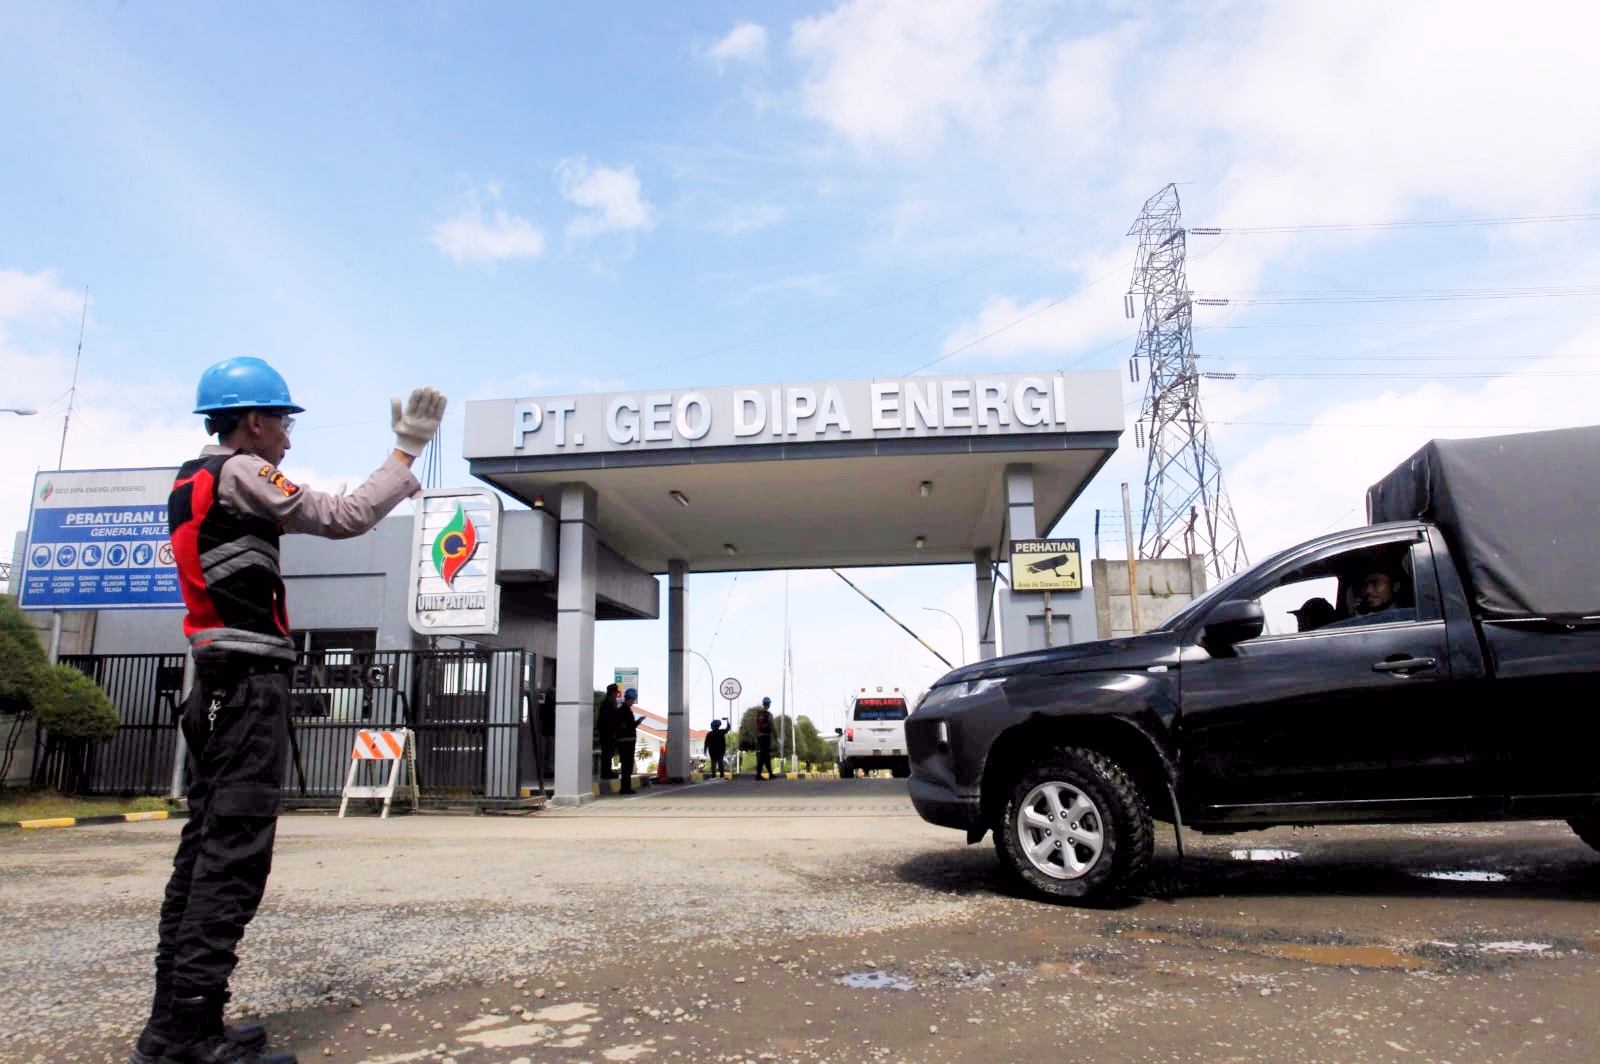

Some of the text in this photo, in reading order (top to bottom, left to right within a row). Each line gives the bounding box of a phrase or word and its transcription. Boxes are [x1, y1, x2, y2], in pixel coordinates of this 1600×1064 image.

[513, 377, 1066, 449] PT. GEO DIPA ENERGI
[66, 511, 154, 525] PERATURAN
[91, 527, 169, 537] GENERAL RULE
[1015, 542, 1076, 553] PERHATIAN
[417, 594, 486, 611] UNIT PATUHA
[724, 686, 734, 695] 20
